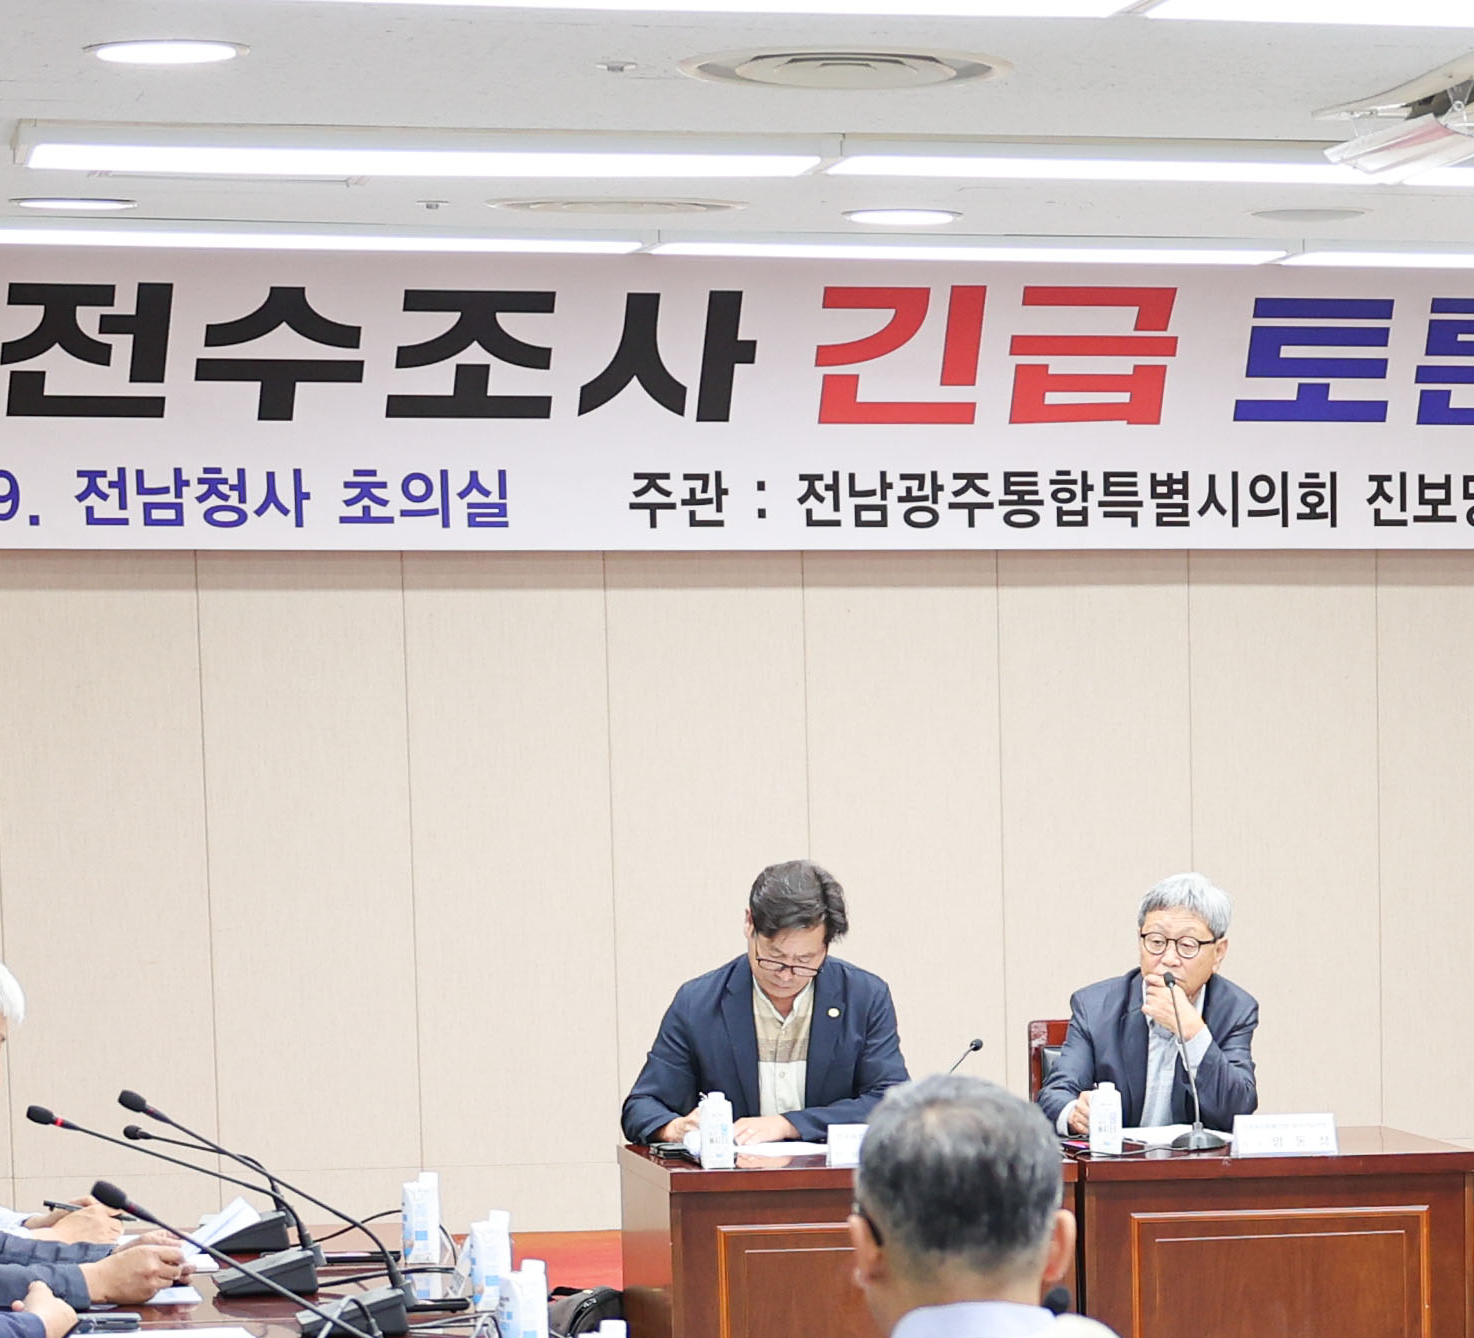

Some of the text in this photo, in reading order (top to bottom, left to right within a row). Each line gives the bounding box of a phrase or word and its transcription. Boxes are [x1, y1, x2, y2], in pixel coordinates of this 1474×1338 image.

[0, 280, 758, 423] 전수조사
[816, 285, 1177, 425] 긴급
[75, 467, 311, 528] 전남청사
[338, 468, 510, 529] 초의실
[628, 470, 730, 530] 주관
[797, 469, 1337, 530] 전남광주통합특별시의회
